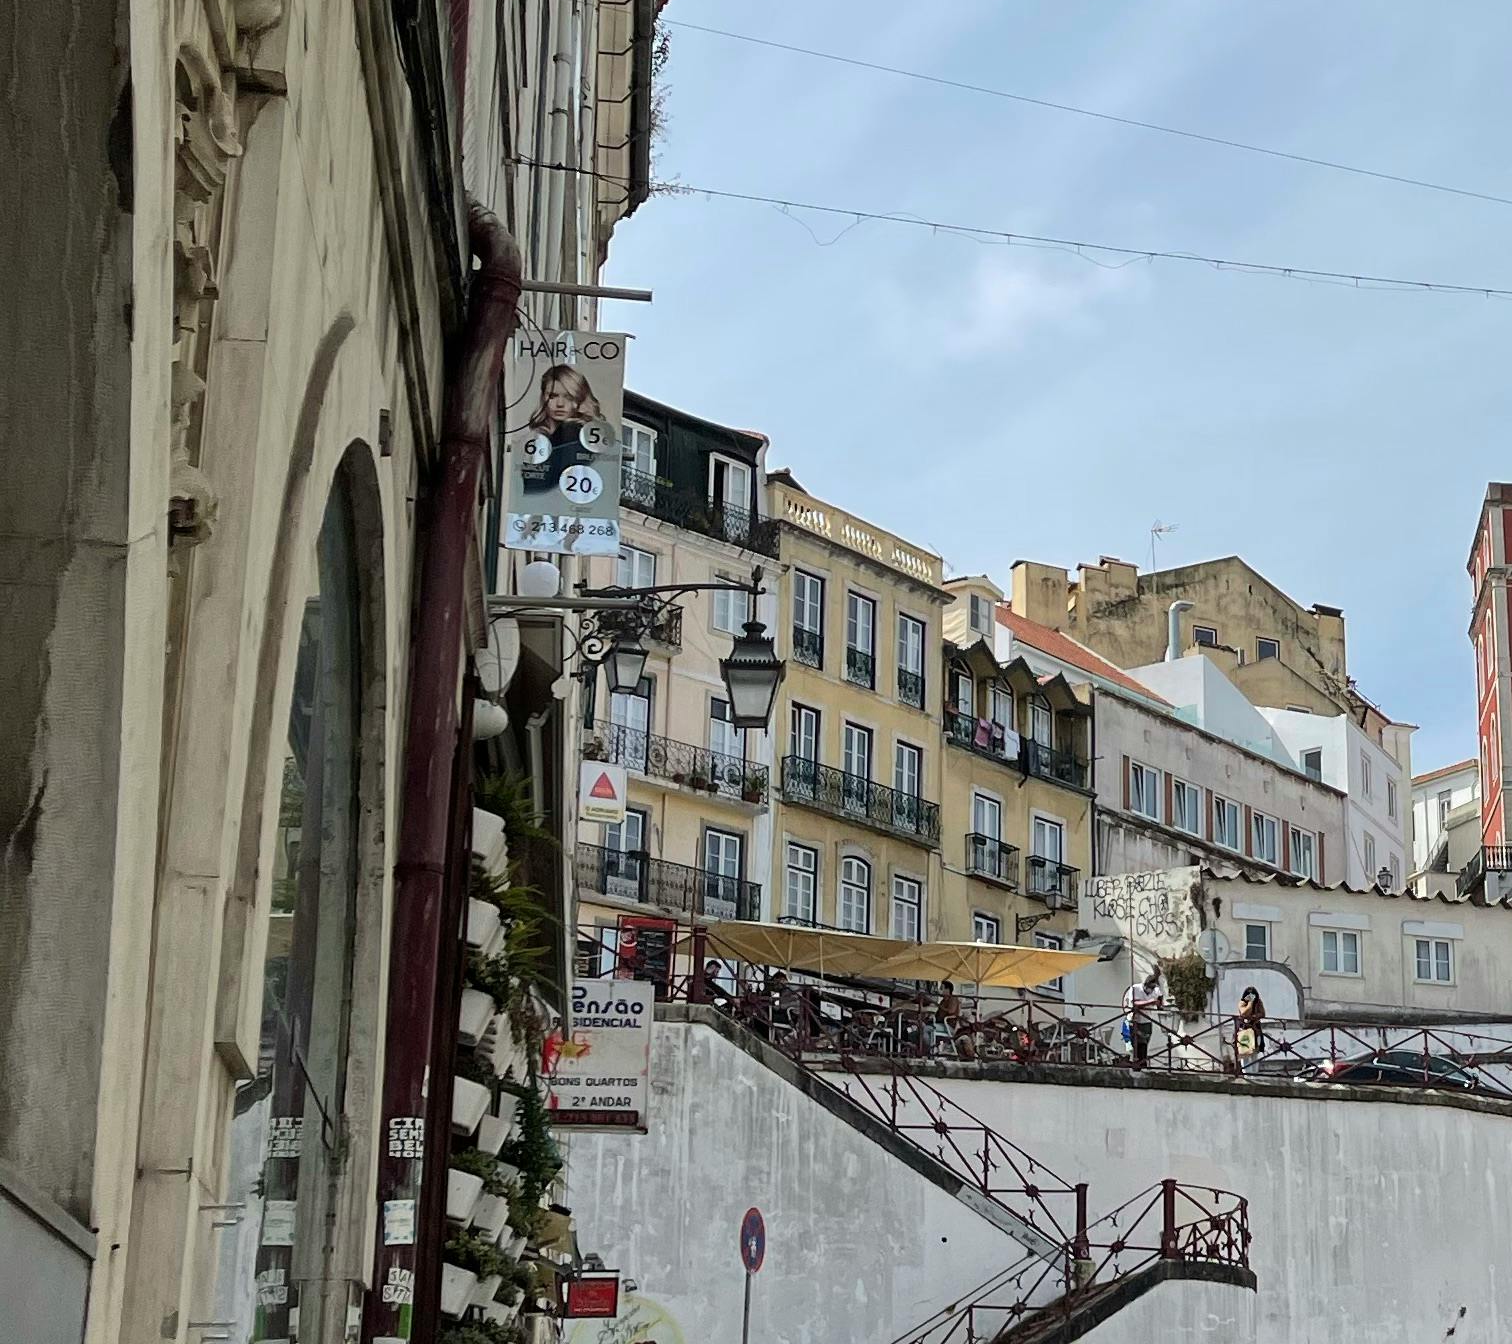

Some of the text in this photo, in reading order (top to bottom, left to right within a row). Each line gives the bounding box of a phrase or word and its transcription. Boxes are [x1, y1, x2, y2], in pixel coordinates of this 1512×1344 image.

[519, 340, 568, 359] HAIR
[583, 341, 620, 360] CO
[588, 426, 610, 446] 5€
[524, 438, 546, 458] 6€
[565, 475, 599, 496] 20€
[531, 520, 555, 534] 213
[588, 524, 614, 537] 268
[550, 1077, 638, 1087] BONS QUARTOS
[589, 1096, 632, 1107] ANDAR
